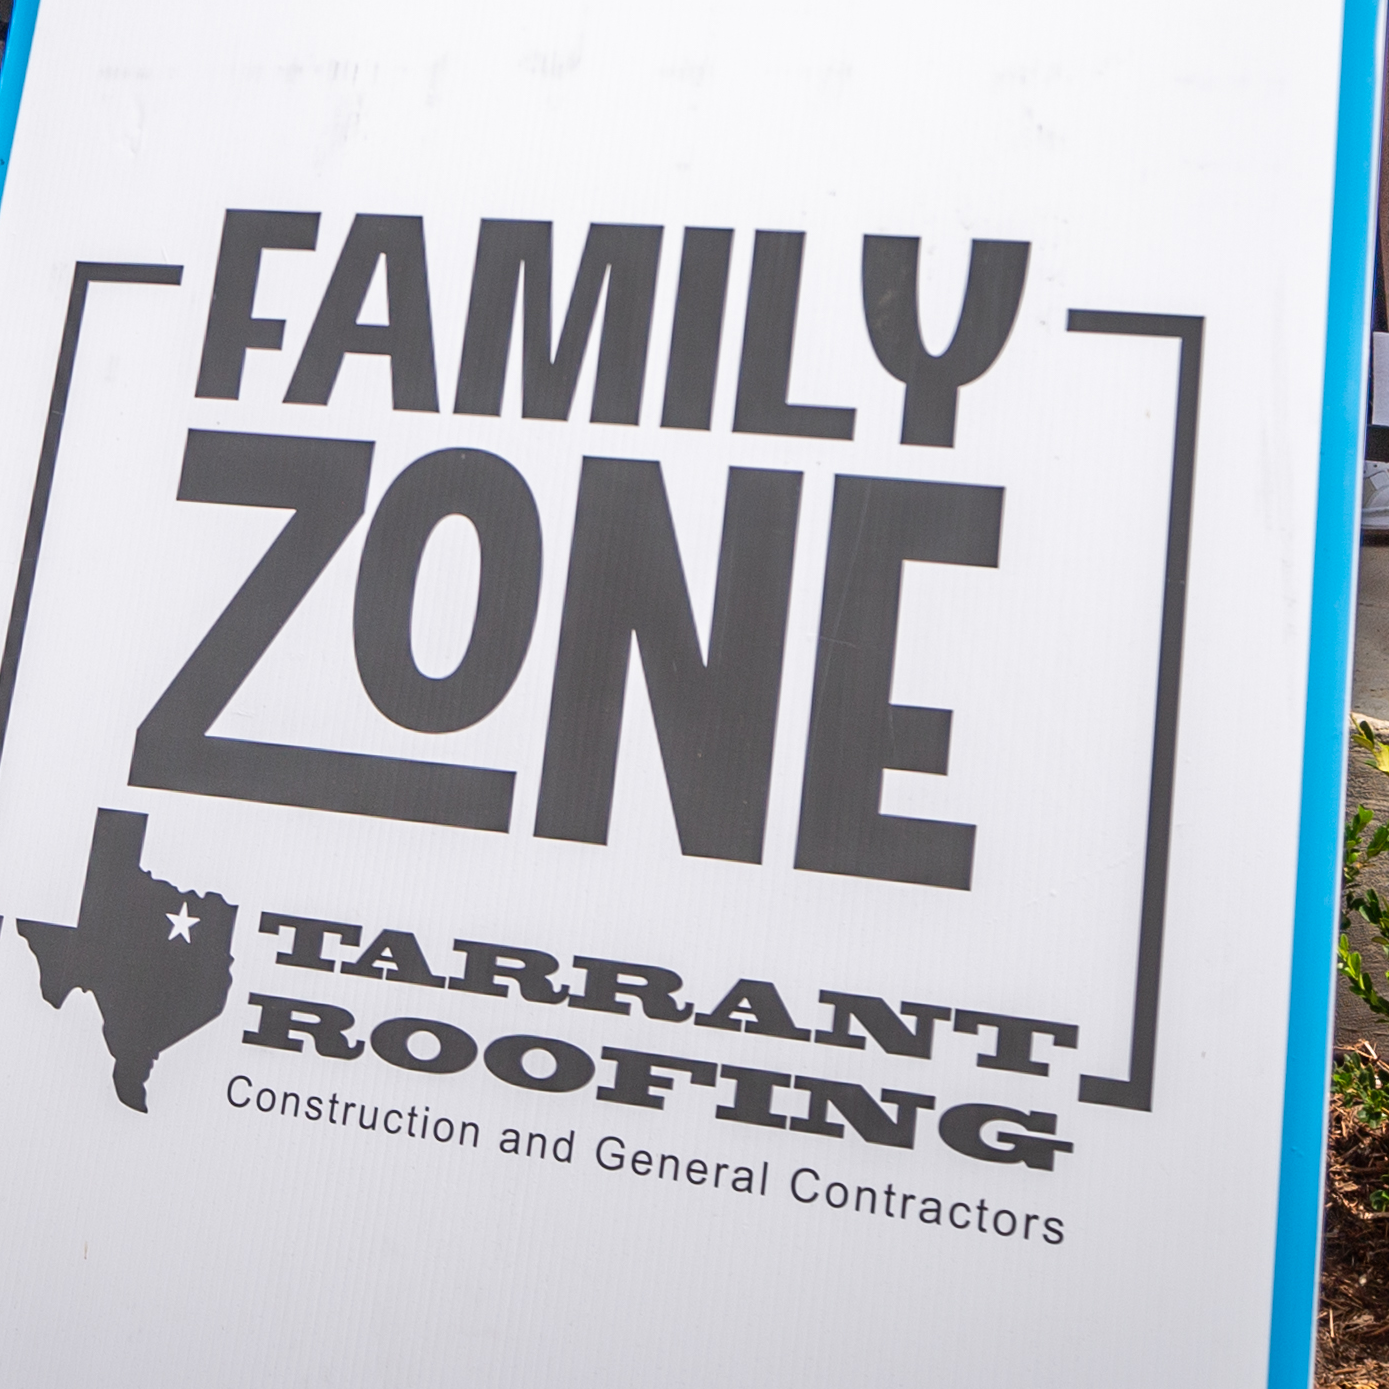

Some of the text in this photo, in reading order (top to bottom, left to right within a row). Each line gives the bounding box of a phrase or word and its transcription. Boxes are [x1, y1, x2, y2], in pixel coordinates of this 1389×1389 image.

[195, 208, 1032, 448] FAMILY
[128, 428, 1006, 892] ZONE
[241, 991, 1075, 1173] ROOFING
[258, 911, 1079, 1077] TARRANT
[226, 1074, 1066, 1247] Construction and General Contractors
